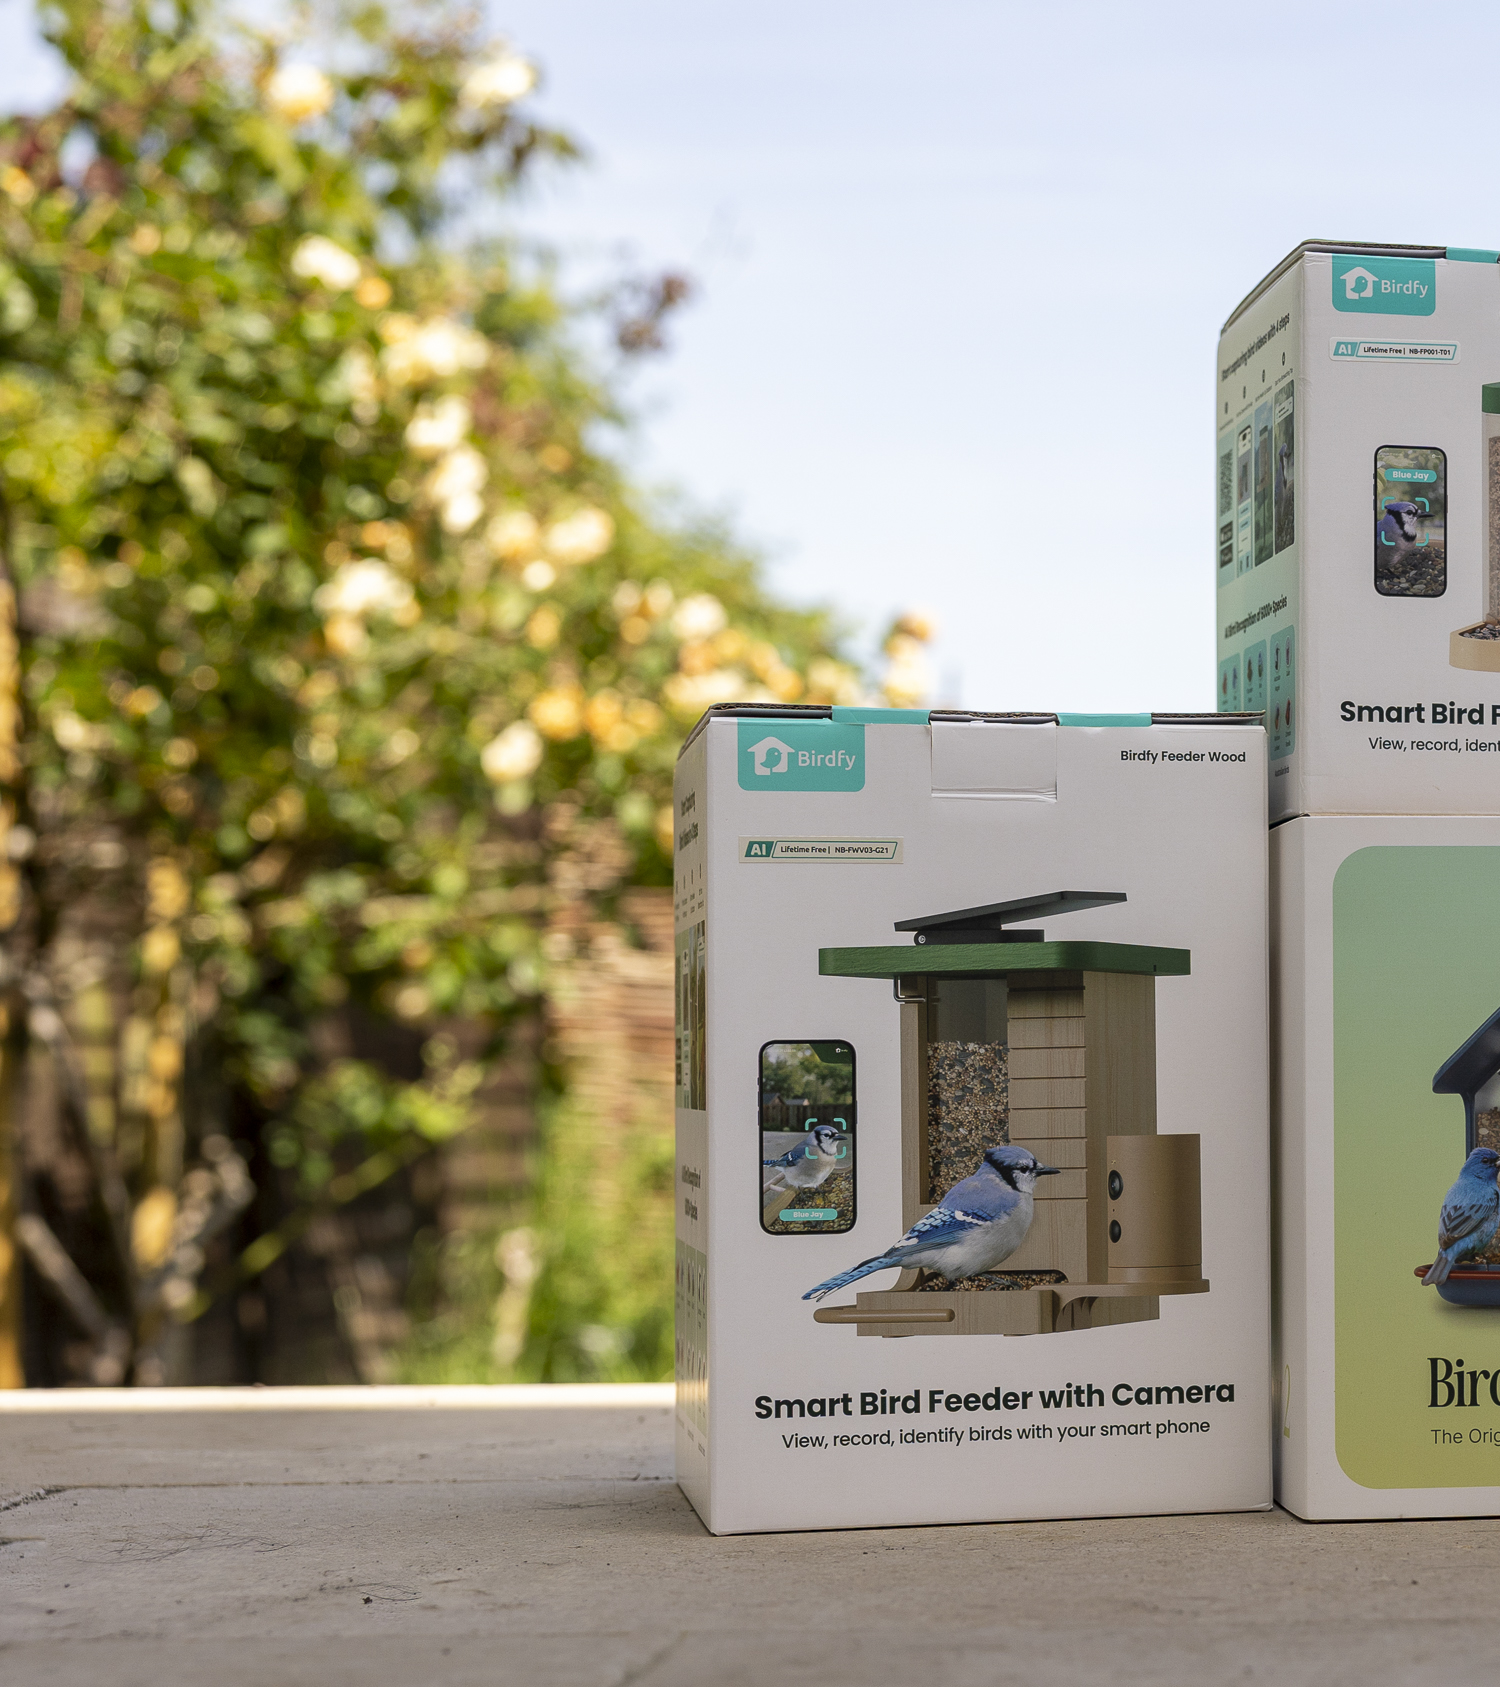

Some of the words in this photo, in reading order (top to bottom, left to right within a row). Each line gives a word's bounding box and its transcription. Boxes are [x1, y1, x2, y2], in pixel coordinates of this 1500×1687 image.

[1381, 279, 1428, 298] Birdfy
[1338, 343, 1352, 355] AI
[1363, 346, 1388, 354] Lifetime
[1392, 470, 1412, 479] Blue
[1413, 471, 1430, 482] Jay
[1340, 700, 1426, 725] Smart
[1431, 701, 1485, 726] Bird
[1368, 736, 1407, 753] View,
[1410, 738, 1462, 754] record,
[798, 749, 856, 771] Birdfy
[1120, 749, 1158, 765] Birdfy
[1161, 750, 1206, 762] Feeder
[1208, 751, 1246, 763] Wood
[750, 843, 767, 856] AI
[780, 845, 810, 854] Lifetime
[810, 846, 827, 854] Free
[793, 1210, 810, 1218] Blue
[810, 1210, 824, 1219] Jay
[754, 1394, 853, 1420] Smart
[859, 1388, 921, 1416] Bird
[928, 1385, 1033, 1414] Feeder
[1038, 1382, 1105, 1410] with
[1110, 1381, 1236, 1407] Camera
[781, 1432, 829, 1450] View,
[833, 1429, 895, 1448] record,
[899, 1426, 965, 1447] identify
[968, 1424, 1013, 1443] birds
[1016, 1423, 1053, 1441] with
[1056, 1423, 1096, 1442] your
[1100, 1420, 1152, 1438] smart
[1155, 1417, 1211, 1439] phone
[1430, 1428, 1463, 1445] The
